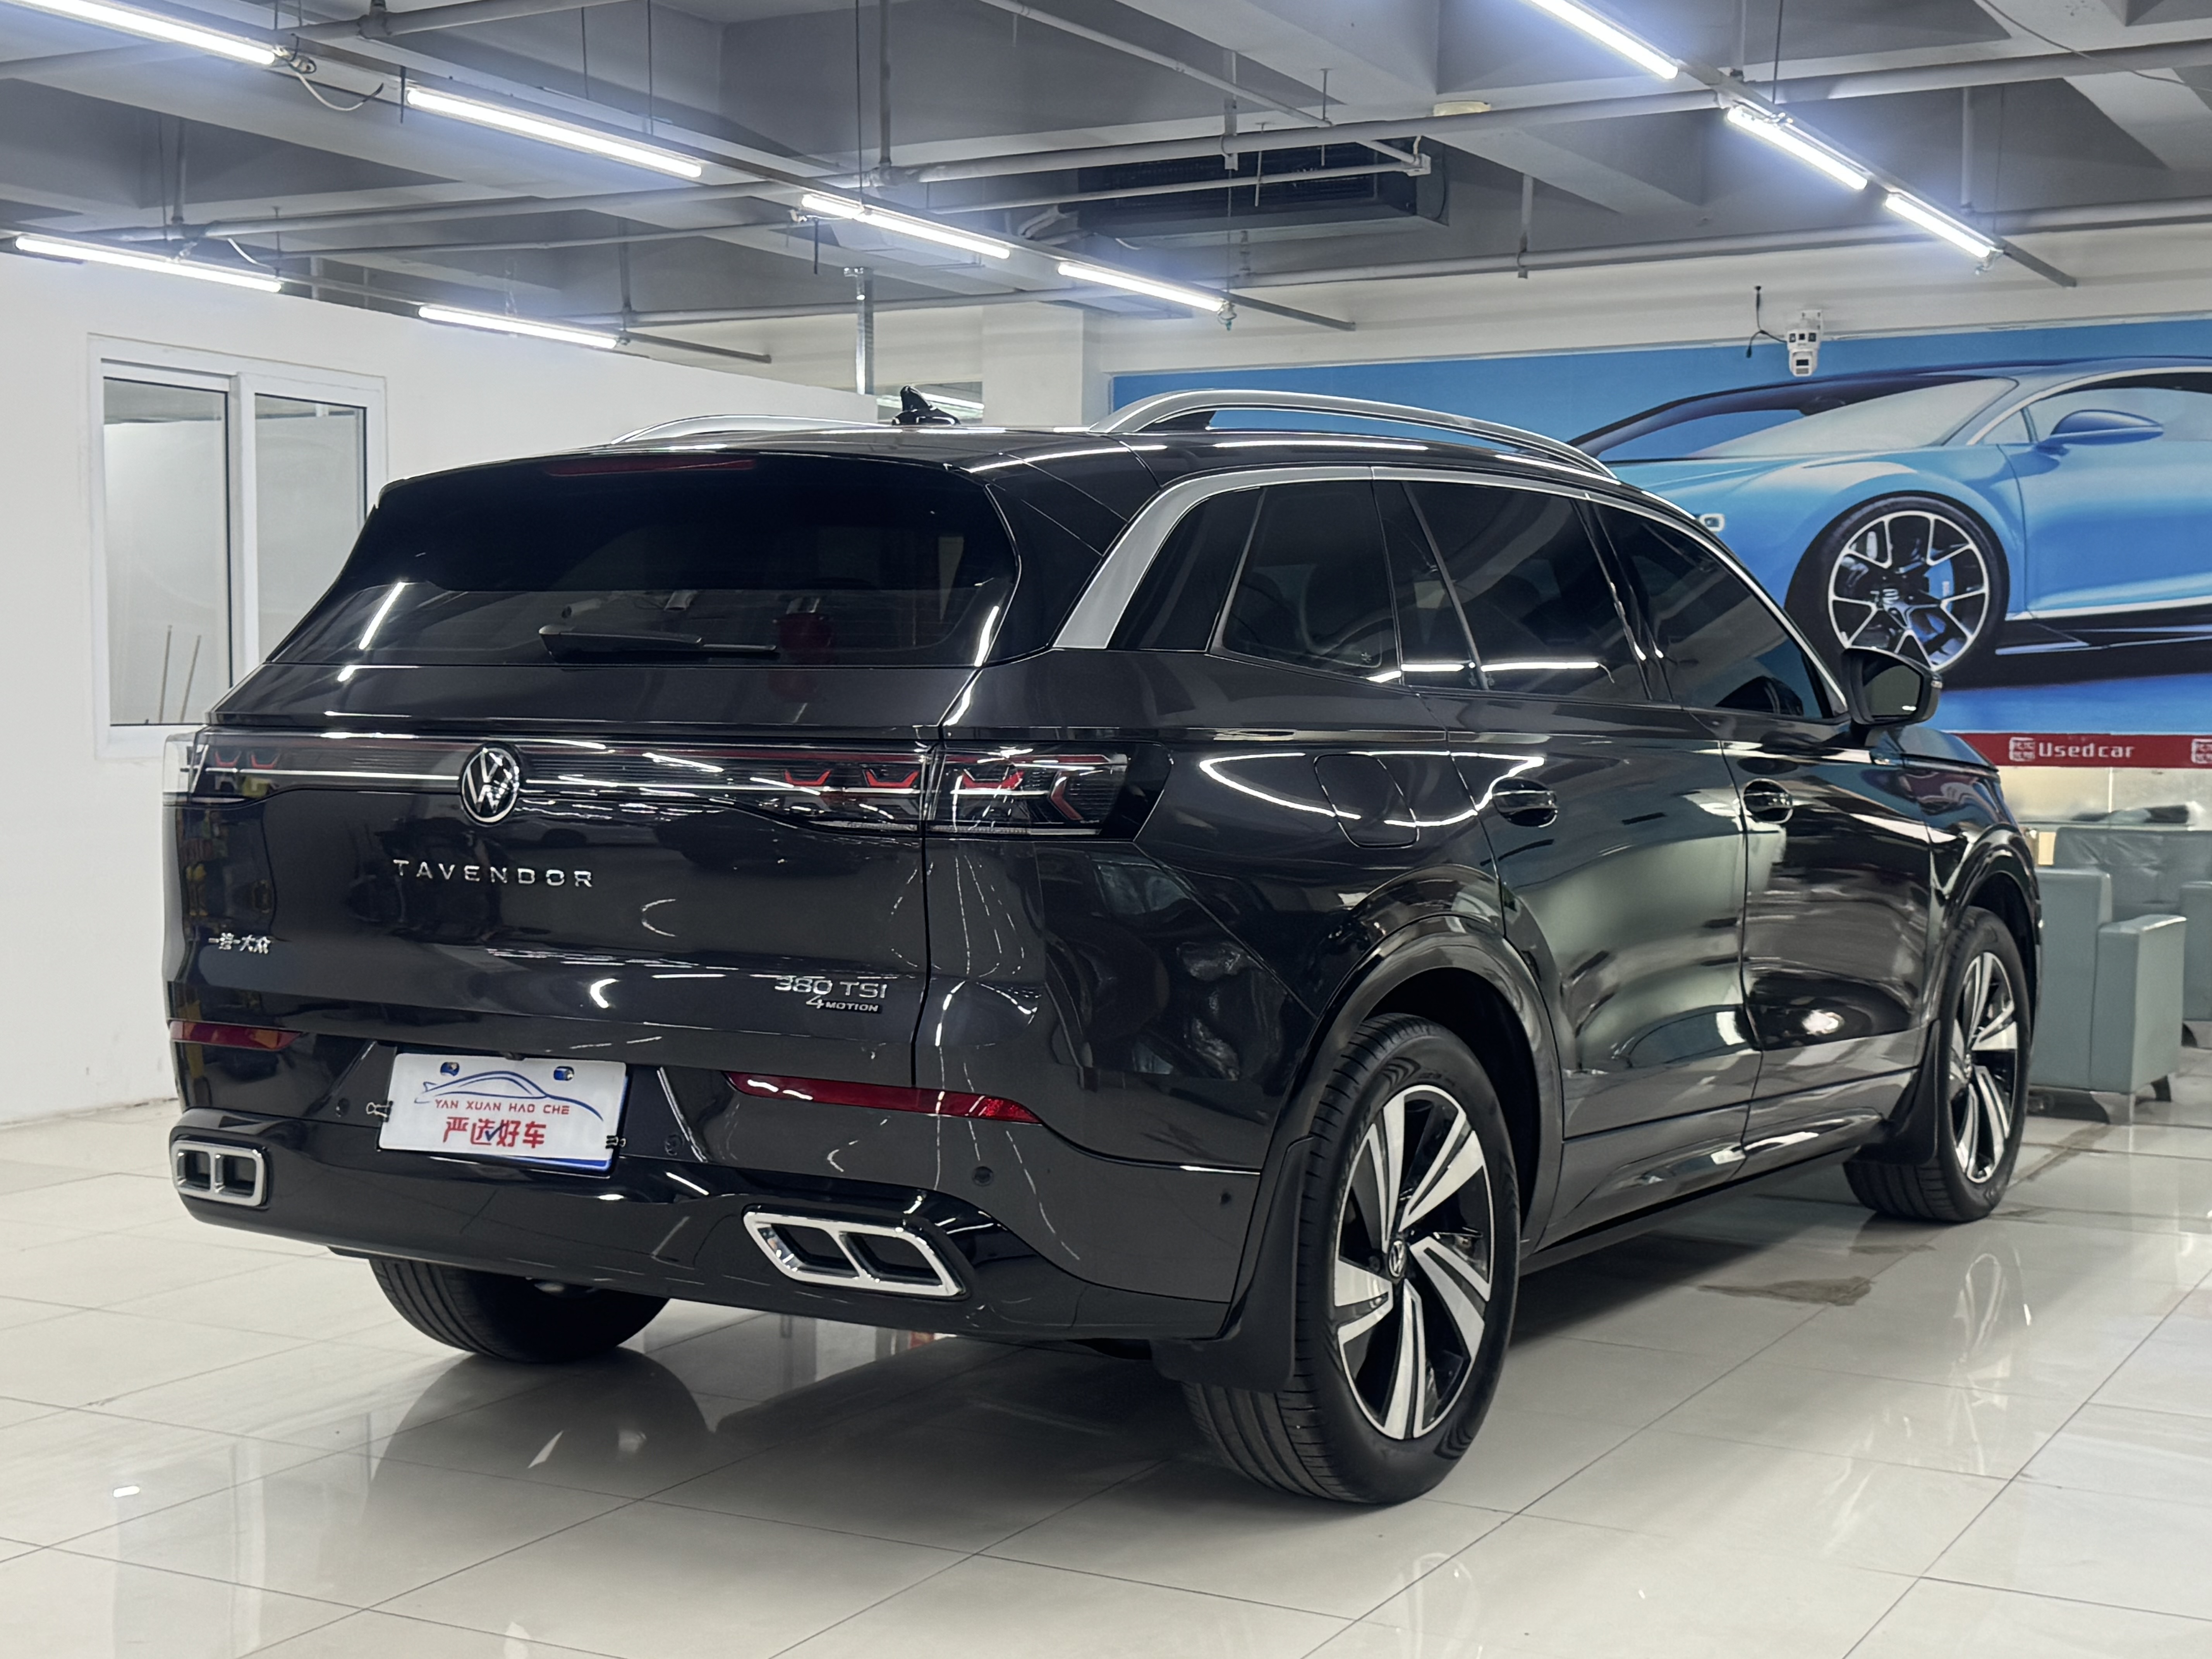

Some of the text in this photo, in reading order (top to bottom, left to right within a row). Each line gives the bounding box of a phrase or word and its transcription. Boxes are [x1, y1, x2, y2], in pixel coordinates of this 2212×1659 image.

[2039, 742, 2135, 758] Usedcar
[393, 859, 592, 887] TAVENDOR
[775, 976, 888, 998] 380 TSI
[806, 995, 879, 1012] 4MOTION
[434, 1099, 570, 1115] YAN XUAN HAO CHE
[443, 1116, 547, 1148] 严选好车
